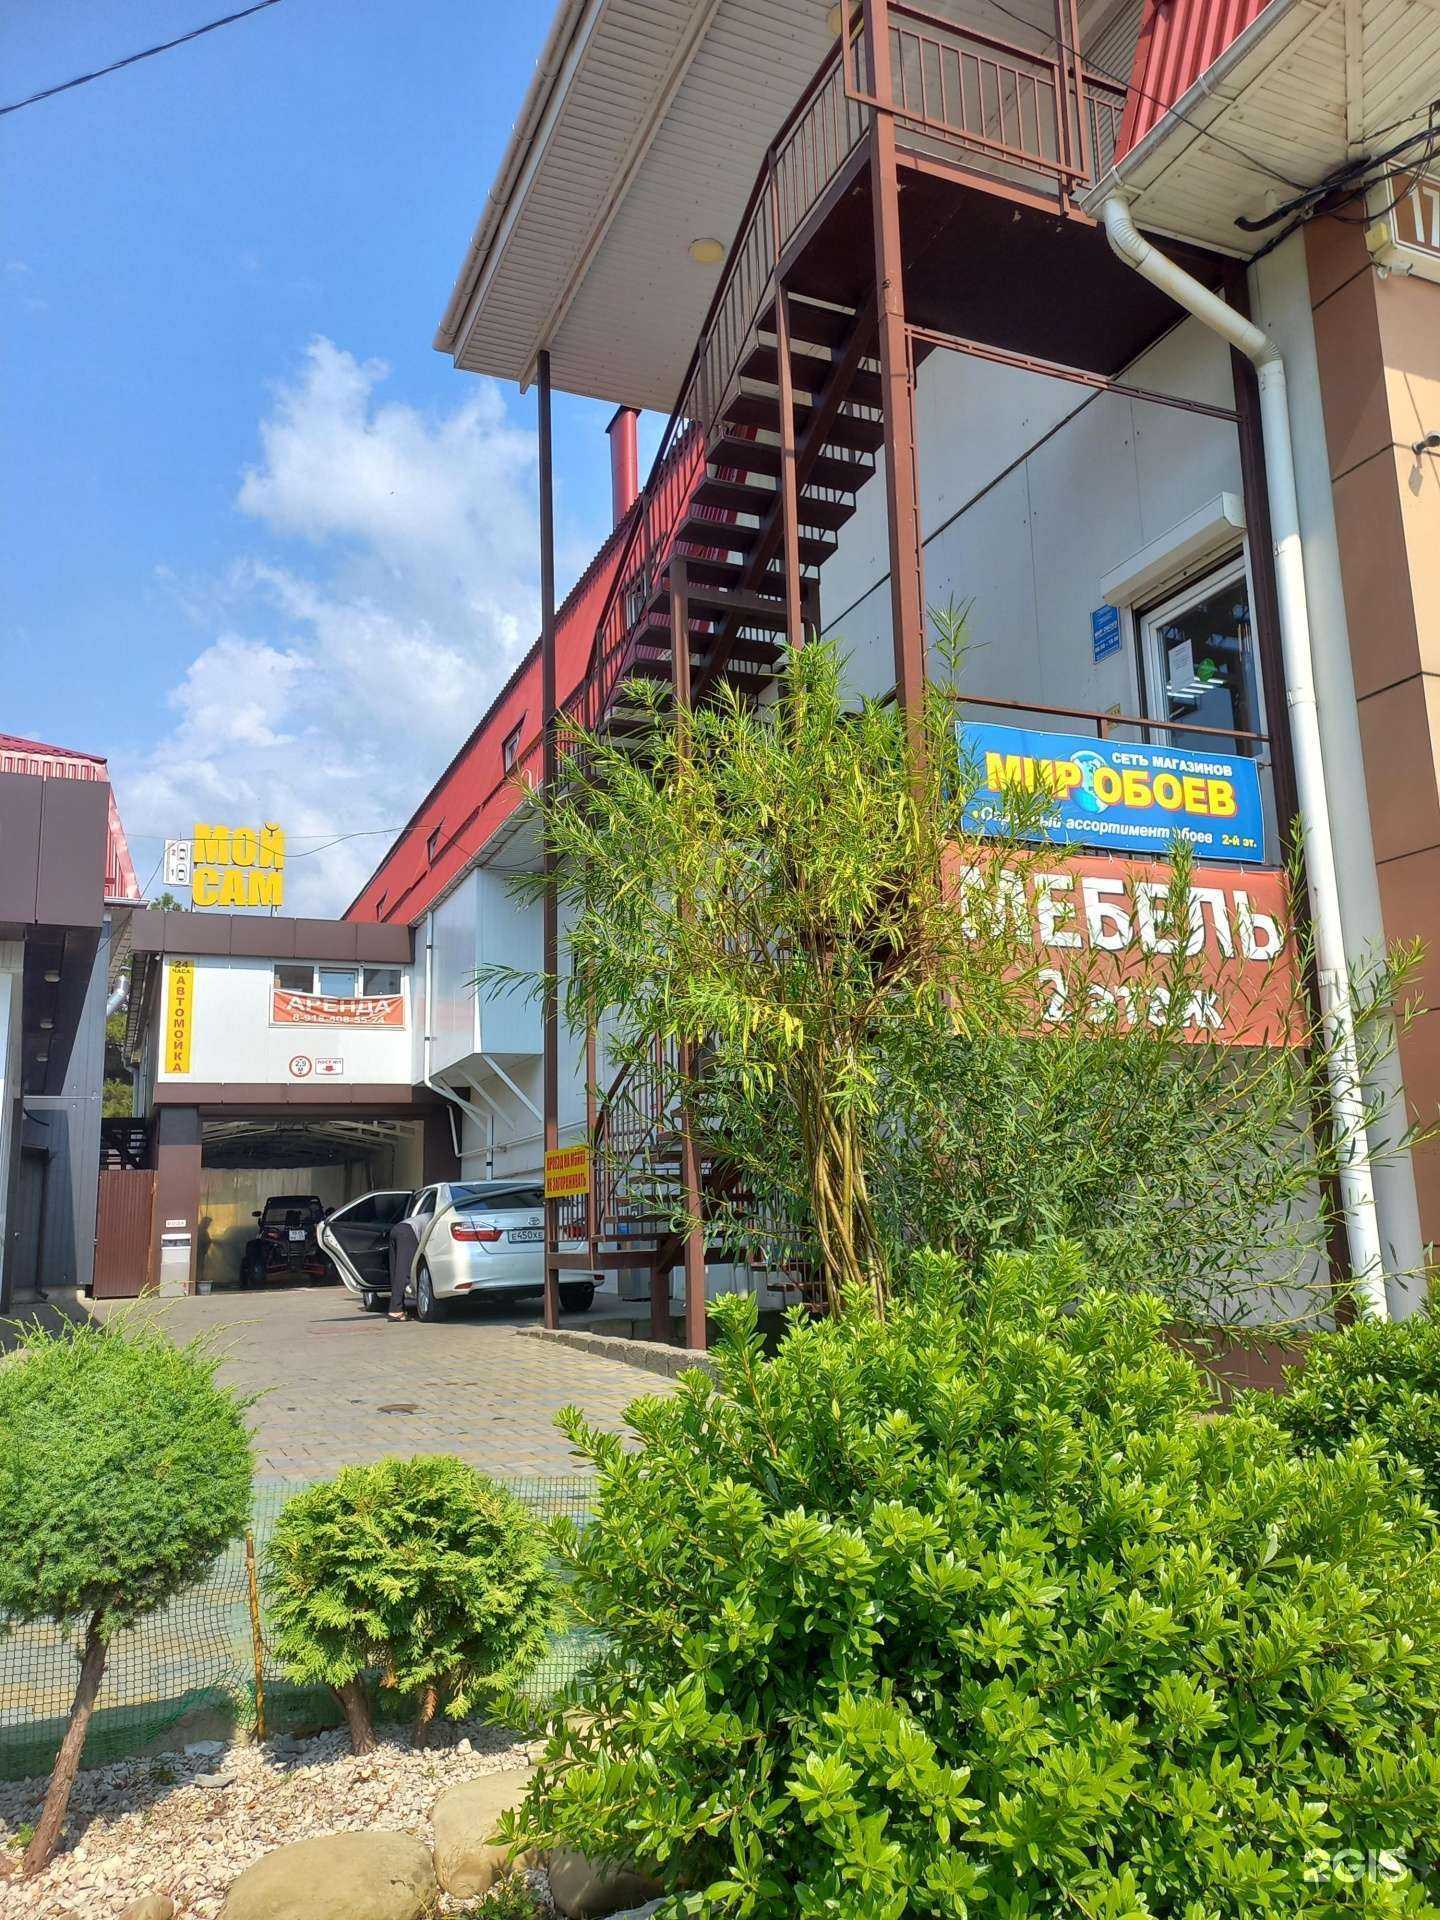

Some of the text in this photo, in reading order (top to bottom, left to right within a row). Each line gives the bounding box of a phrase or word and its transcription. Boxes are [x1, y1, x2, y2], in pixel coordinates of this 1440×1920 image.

[985, 751, 1238, 818] МИР ОБОЕВ
[1112, 752, 1233, 777] СЕТЬ МАГАЗИНОВ
[193, 823, 285, 869] МОЙ
[1065, 818, 1170, 839] ассортимент
[192, 867, 283, 907] САМ
[960, 864, 1285, 961] МЕБЕЛЬ
[175, 960, 188, 968] 24
[173, 976, 186, 1072] АВТОМОЙКА
[287, 997, 392, 1016] АРЕНДА
